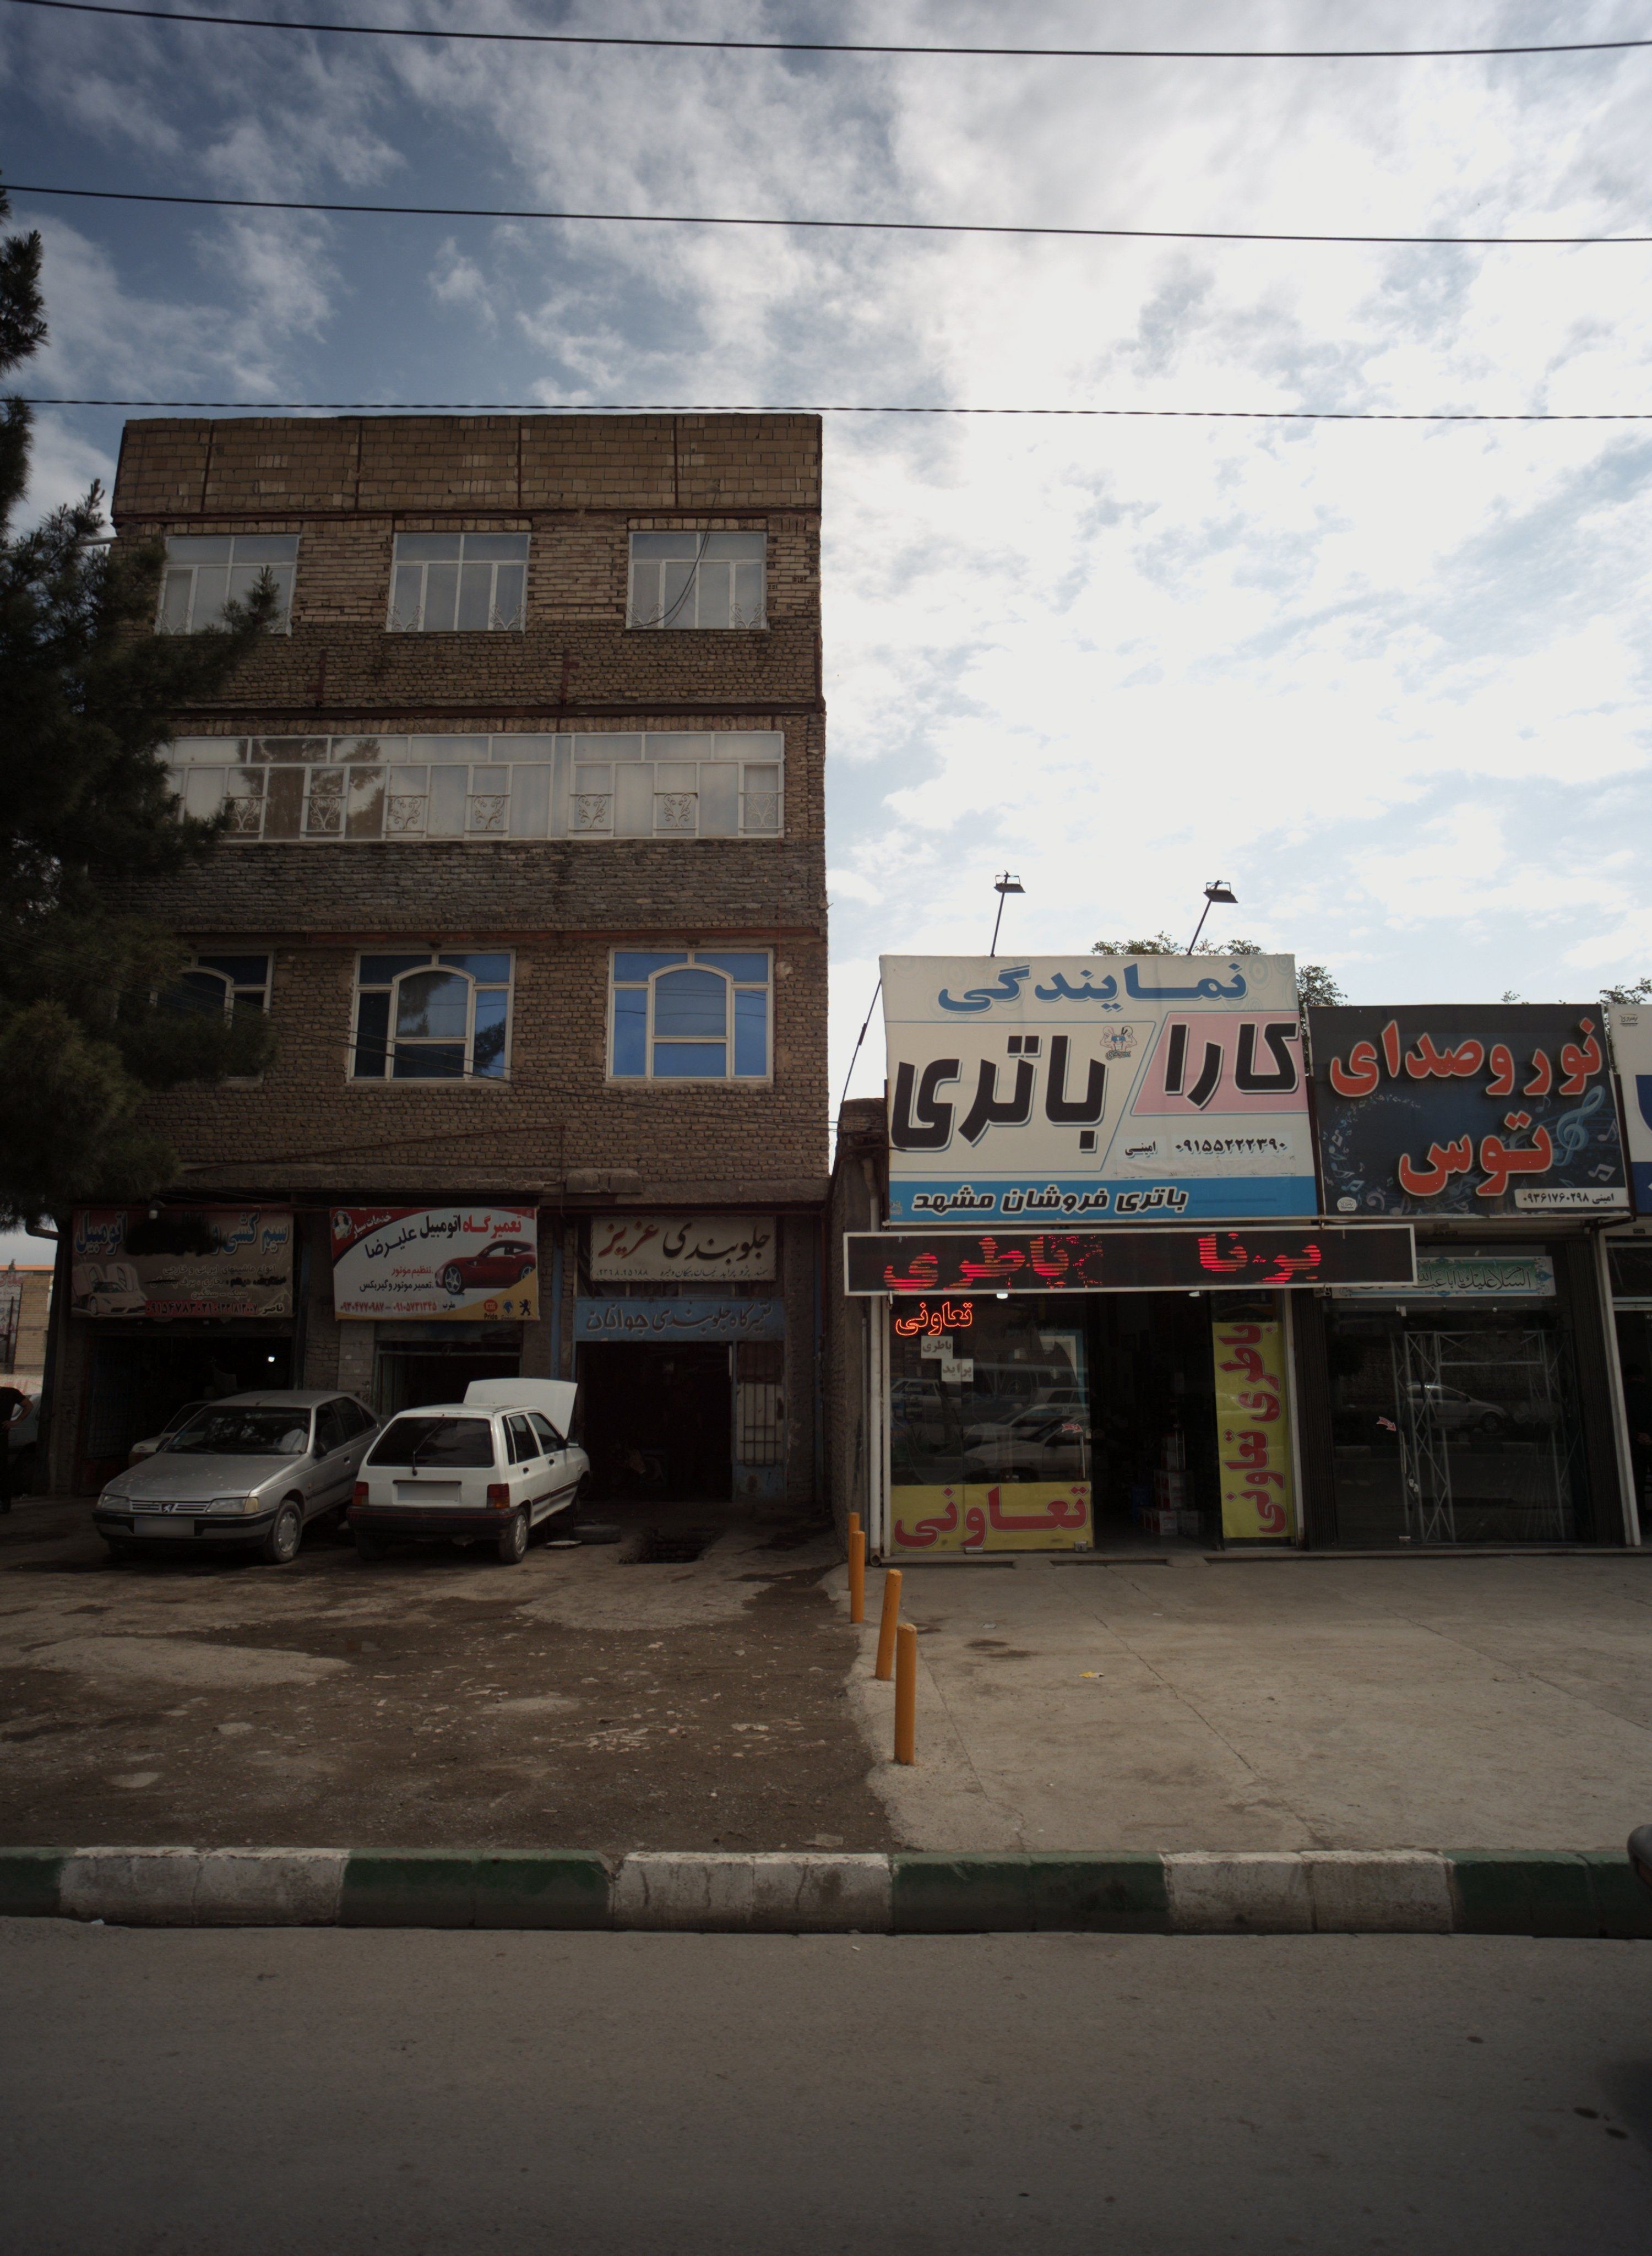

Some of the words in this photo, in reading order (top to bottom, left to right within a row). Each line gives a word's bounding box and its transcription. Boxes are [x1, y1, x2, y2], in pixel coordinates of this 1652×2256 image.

[938, 963, 1247, 1012] نمایندگی
[1163, 1022, 1299, 1109] کارا
[1329, 1019, 1485, 1097] صدای
[892, 1035, 1108, 1153] باتری
[1125, 1141, 1157, 1157] امینی
[1175, 1137, 1287, 1154] ۰۹۱۵۵۲۲۲۳۹۰
[1398, 1110, 1553, 1196] توس
[911, 1184, 995, 1216] مشهد
[1000, 1184, 1109, 1215] فروشان
[1115, 1186, 1189, 1214] باتری
[74, 1211, 128, 1256] اتومبیل
[261, 1223, 289, 1255] سیم
[365, 1227, 417, 1259] علیرضا
[420, 1214, 461, 1239] اتومبیل
[598, 1220, 660, 1259] عزیز
[895, 1300, 974, 1336] تعاونی
[922, 1340, 952, 1353] باطری
[942, 1363, 973, 1378] پراید
[1218, 1324, 1282, 1423] باطری
[1223, 1429, 1287, 1534] تعاونی
[893, 1485, 1090, 1549] تعاونی
